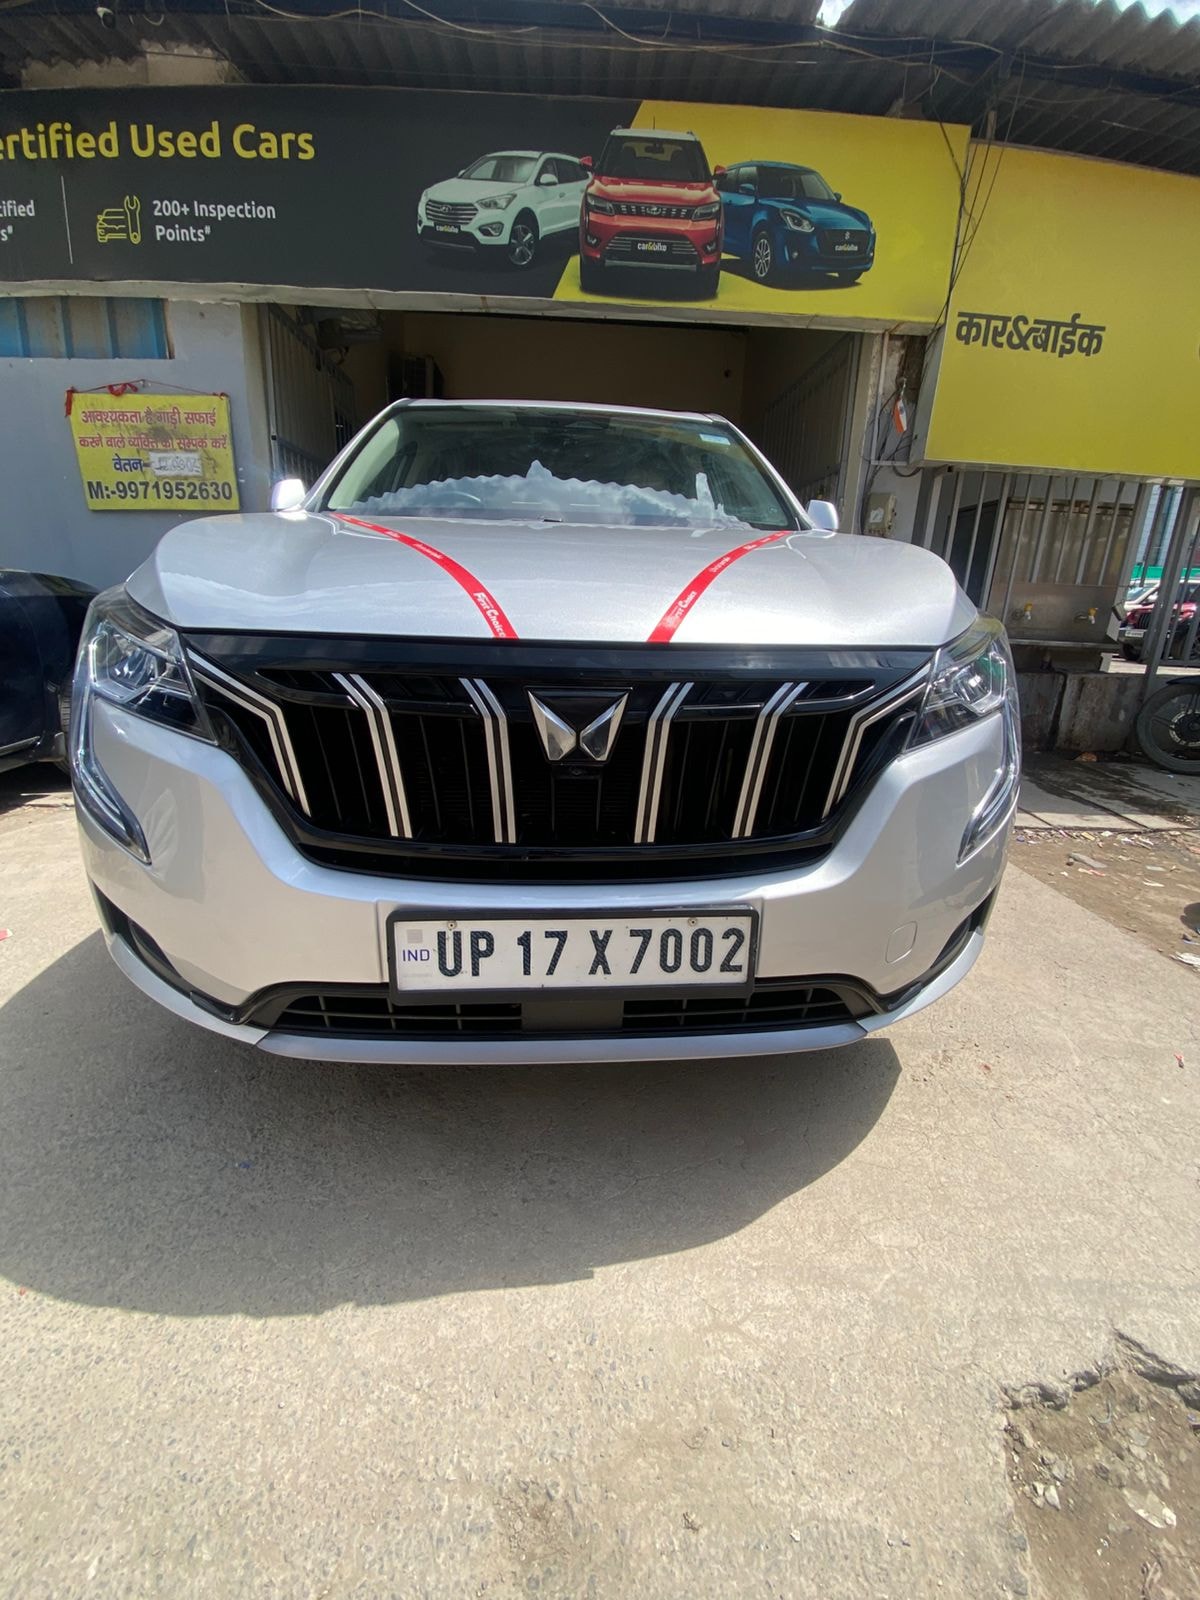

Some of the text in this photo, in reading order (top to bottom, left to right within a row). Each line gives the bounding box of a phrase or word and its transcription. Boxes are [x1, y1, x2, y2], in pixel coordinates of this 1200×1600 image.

[0, 121, 315, 160] rtified Used Cars
[153, 200, 276, 221] 200+ Inspection
[155, 225, 212, 242] Points#
[637, 241, 667, 252] car&bike
[956, 311, 1106, 358] कार&बाईक
[81, 410, 142, 425] आवश्यकता
[183, 407, 216, 427] सफाई
[104, 433, 125, 448] वाले
[87, 481, 233, 500] M:-9971952630
[402, 949, 430, 962] IND
[437, 927, 745, 977] UP 17 X 7002
